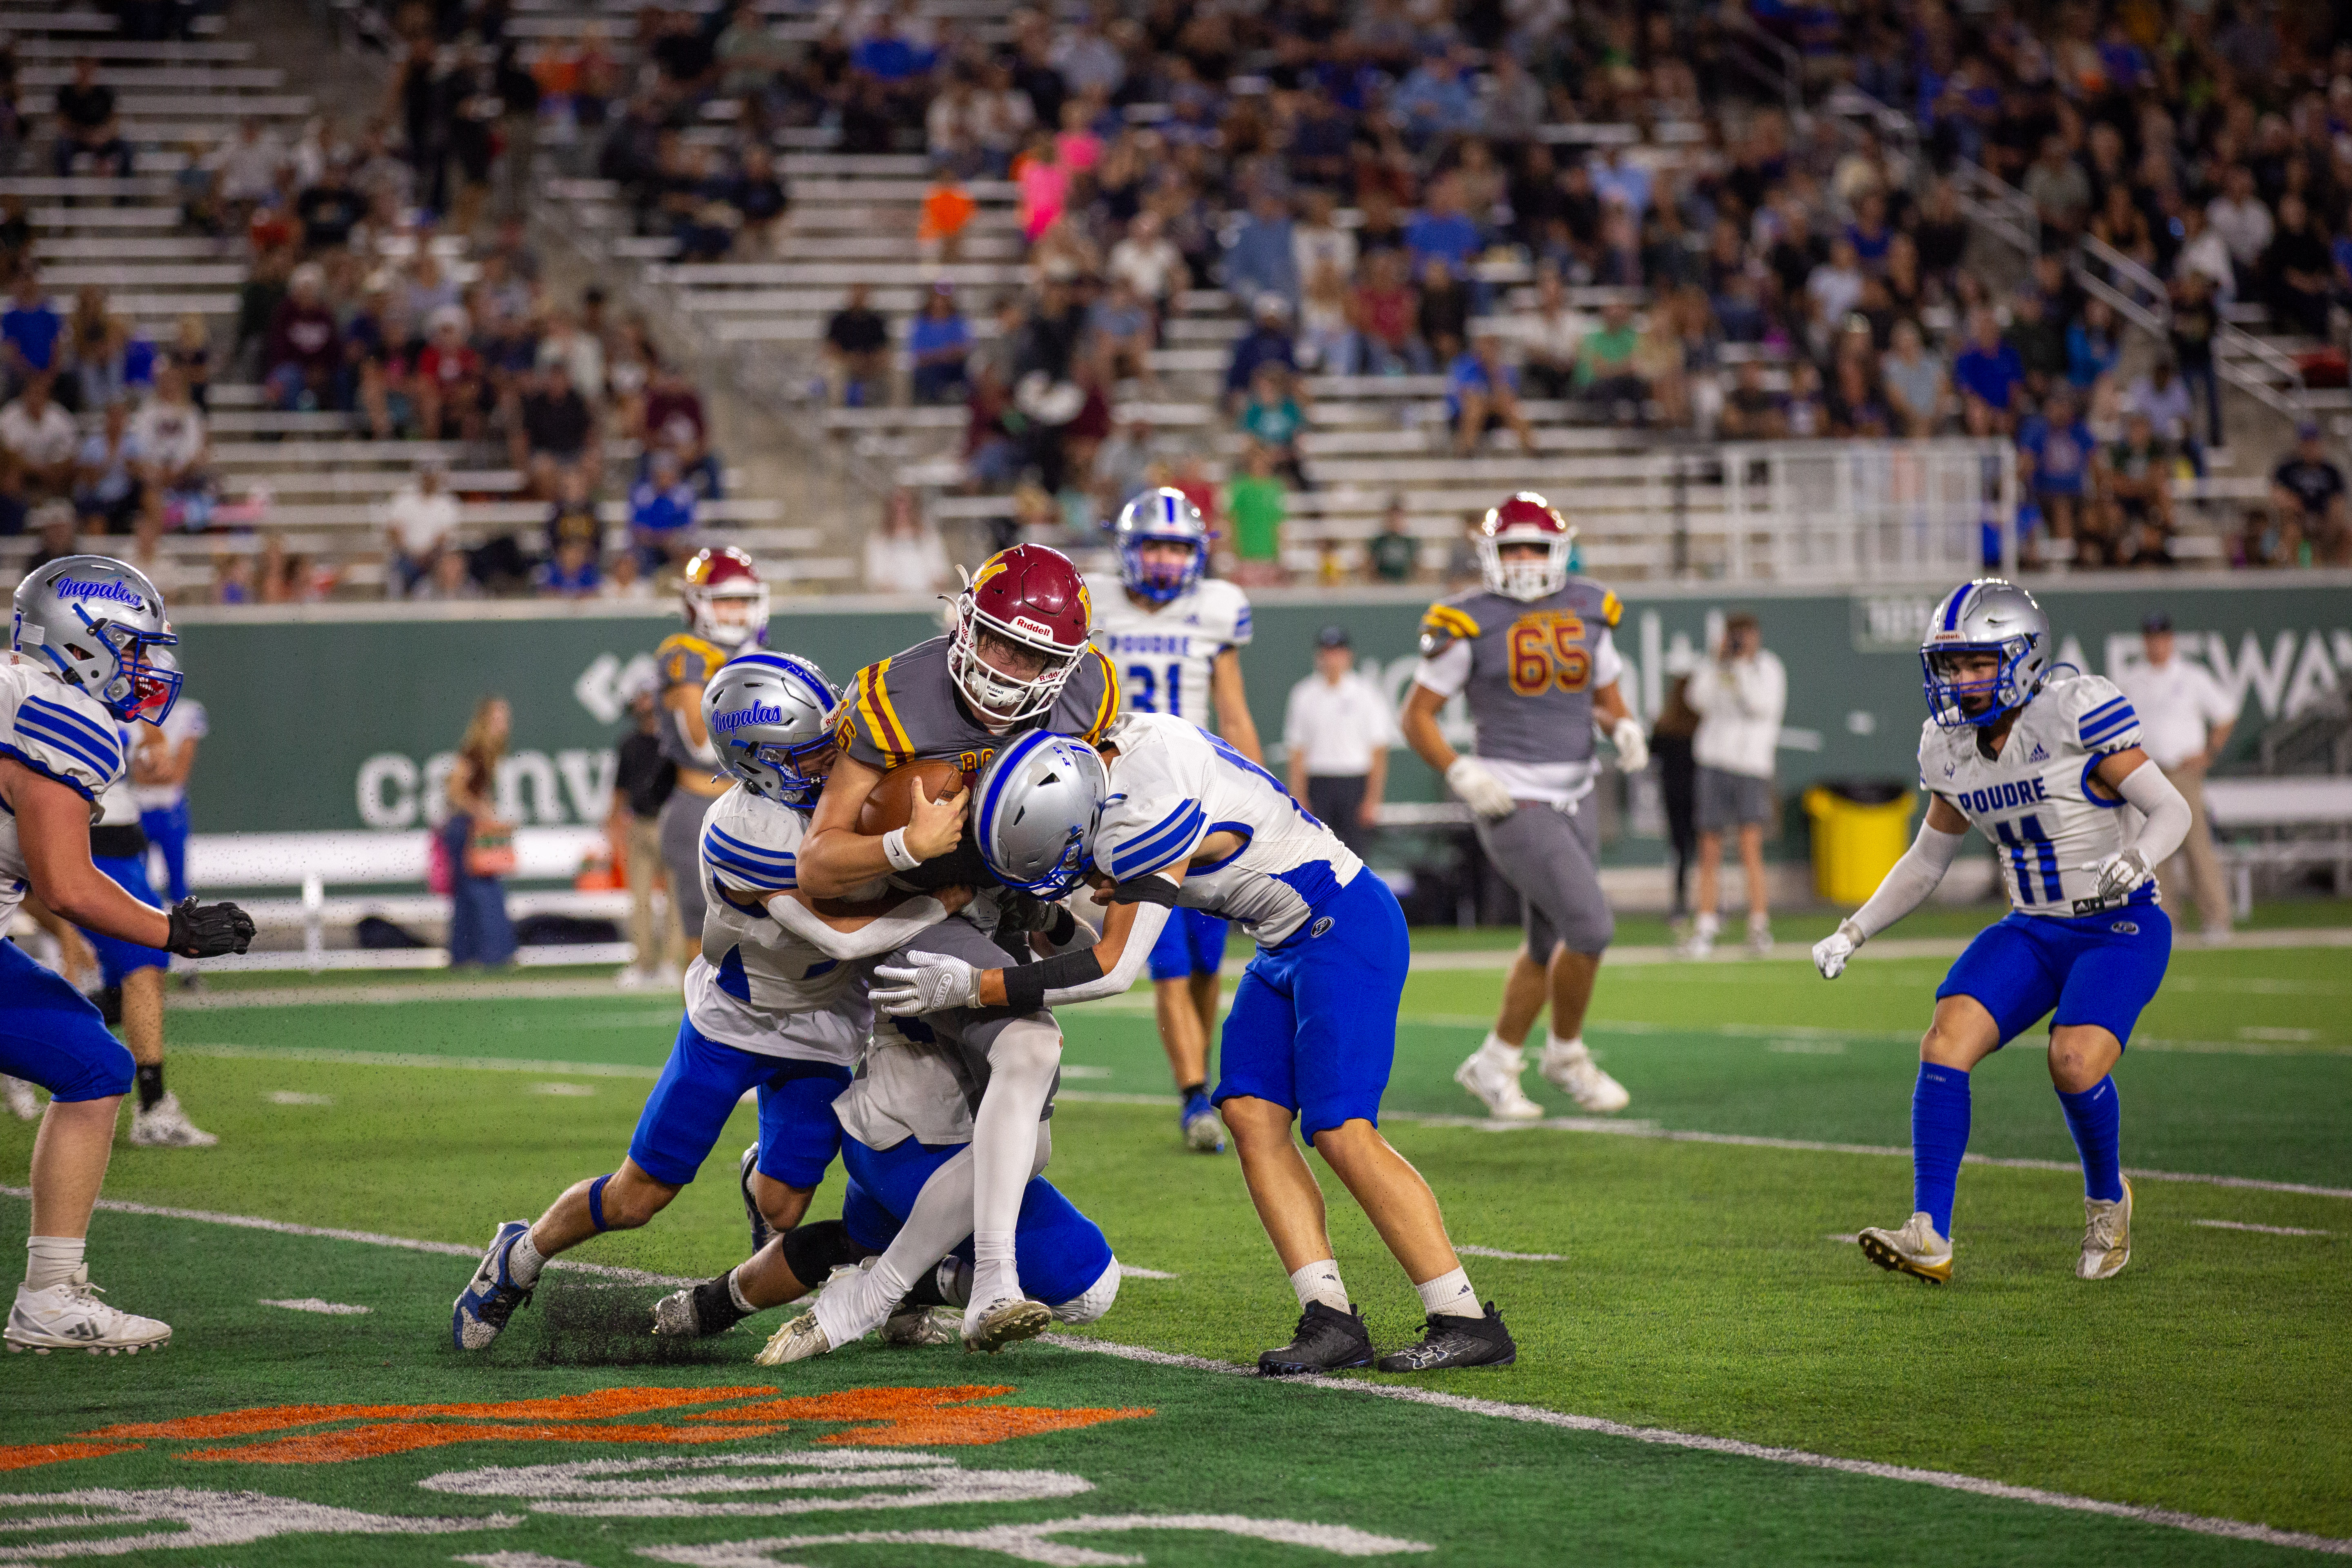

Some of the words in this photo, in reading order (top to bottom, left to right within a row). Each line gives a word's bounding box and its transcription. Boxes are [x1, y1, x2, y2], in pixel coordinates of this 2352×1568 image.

[56, 577, 142, 608] Impalas
[1017, 618, 1050, 636] Riddell
[1506, 617, 1592, 697] 65
[987, 685, 1004, 695] Riddell
[712, 699, 782, 735] Impalas
[1958, 777, 2051, 814] POUDRE
[1996, 814, 2065, 904] 11
[933, 977, 950, 1008] BATTLE
